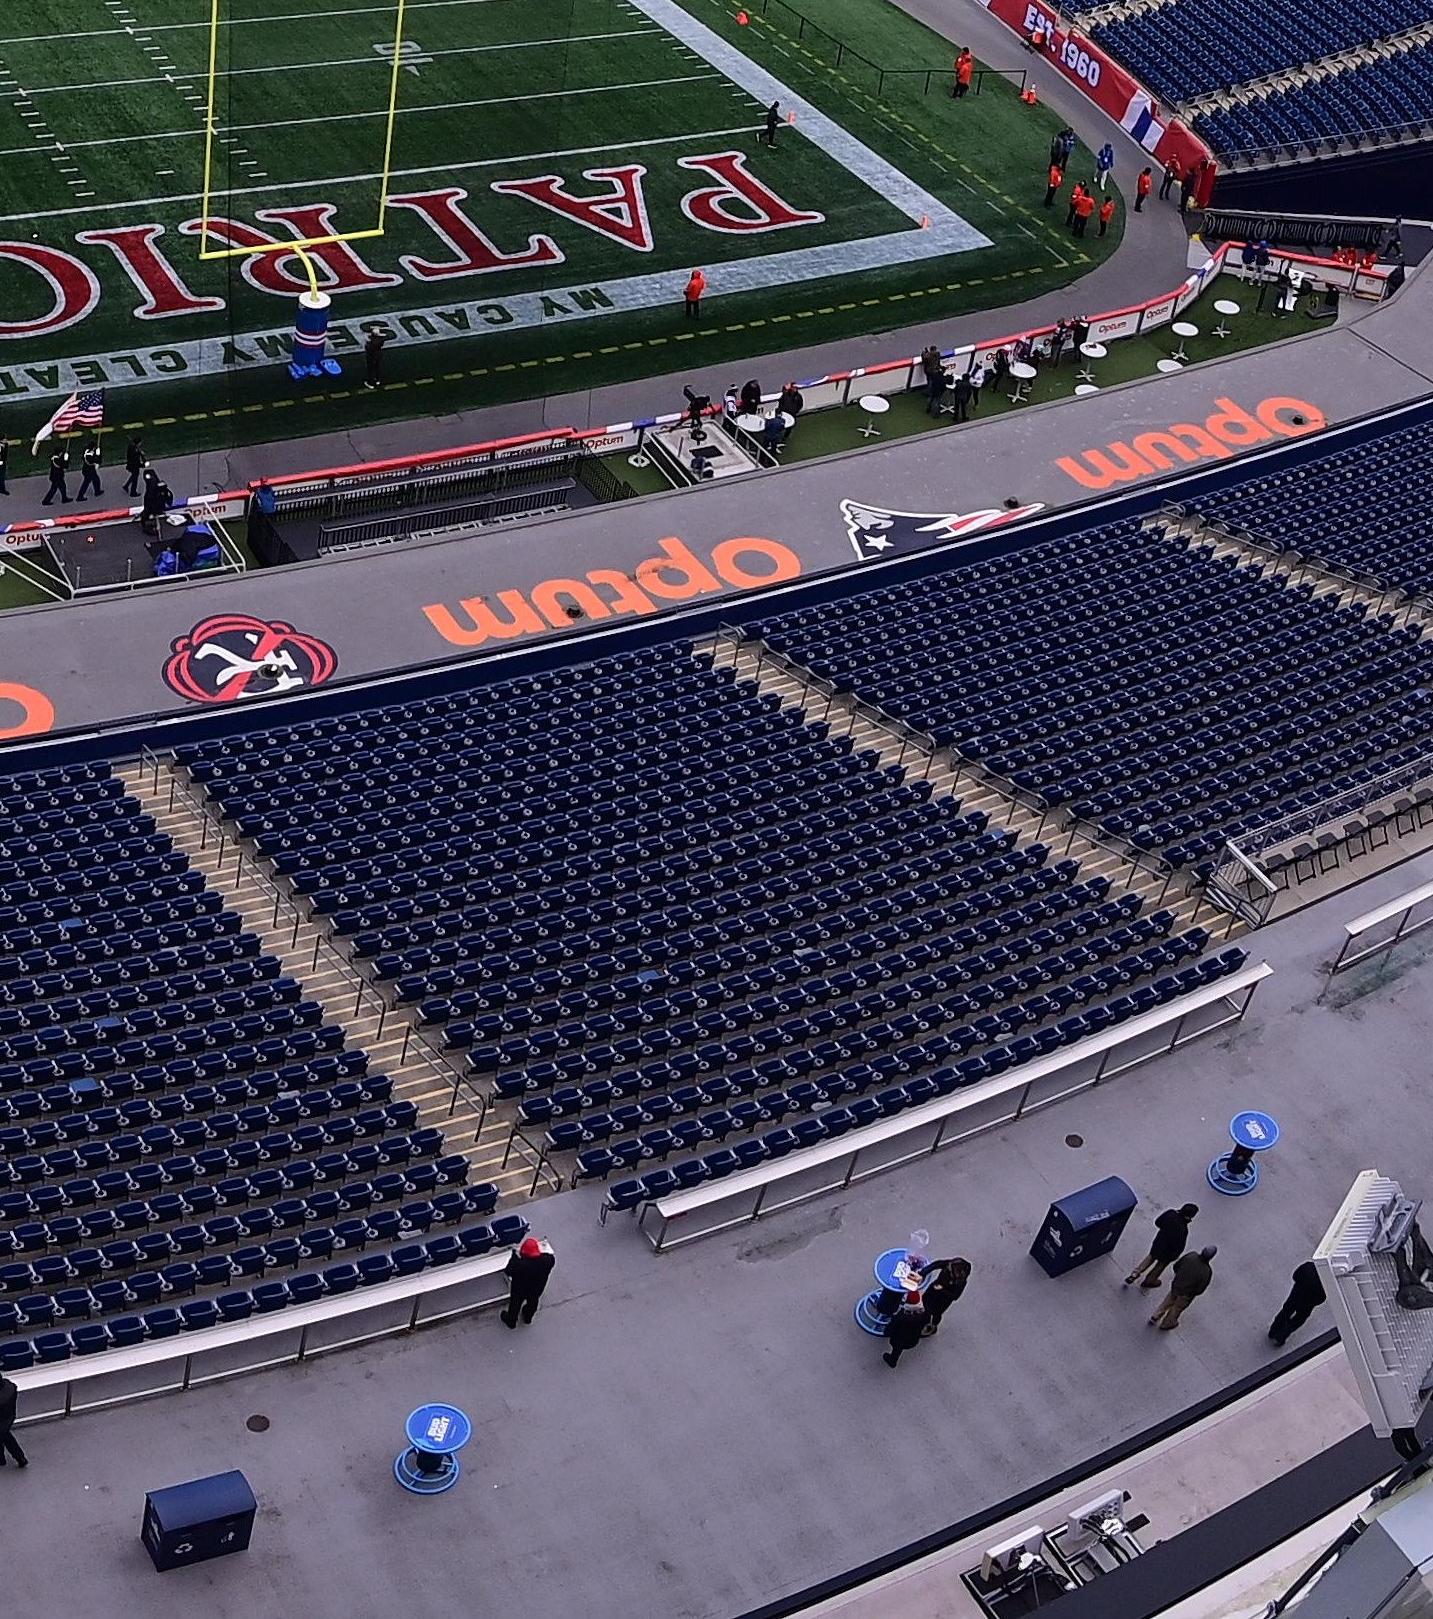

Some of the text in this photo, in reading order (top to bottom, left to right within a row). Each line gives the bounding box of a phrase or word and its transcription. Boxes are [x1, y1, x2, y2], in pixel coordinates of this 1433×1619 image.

[1061, 38, 1100, 87] 1960
[543, 285, 616, 318] MY
[1098, 319, 1127, 335] Optum
[587, 434, 623, 449] Optum
[1056, 396, 1326, 489] Optum
[422, 536, 801, 646] Optum
